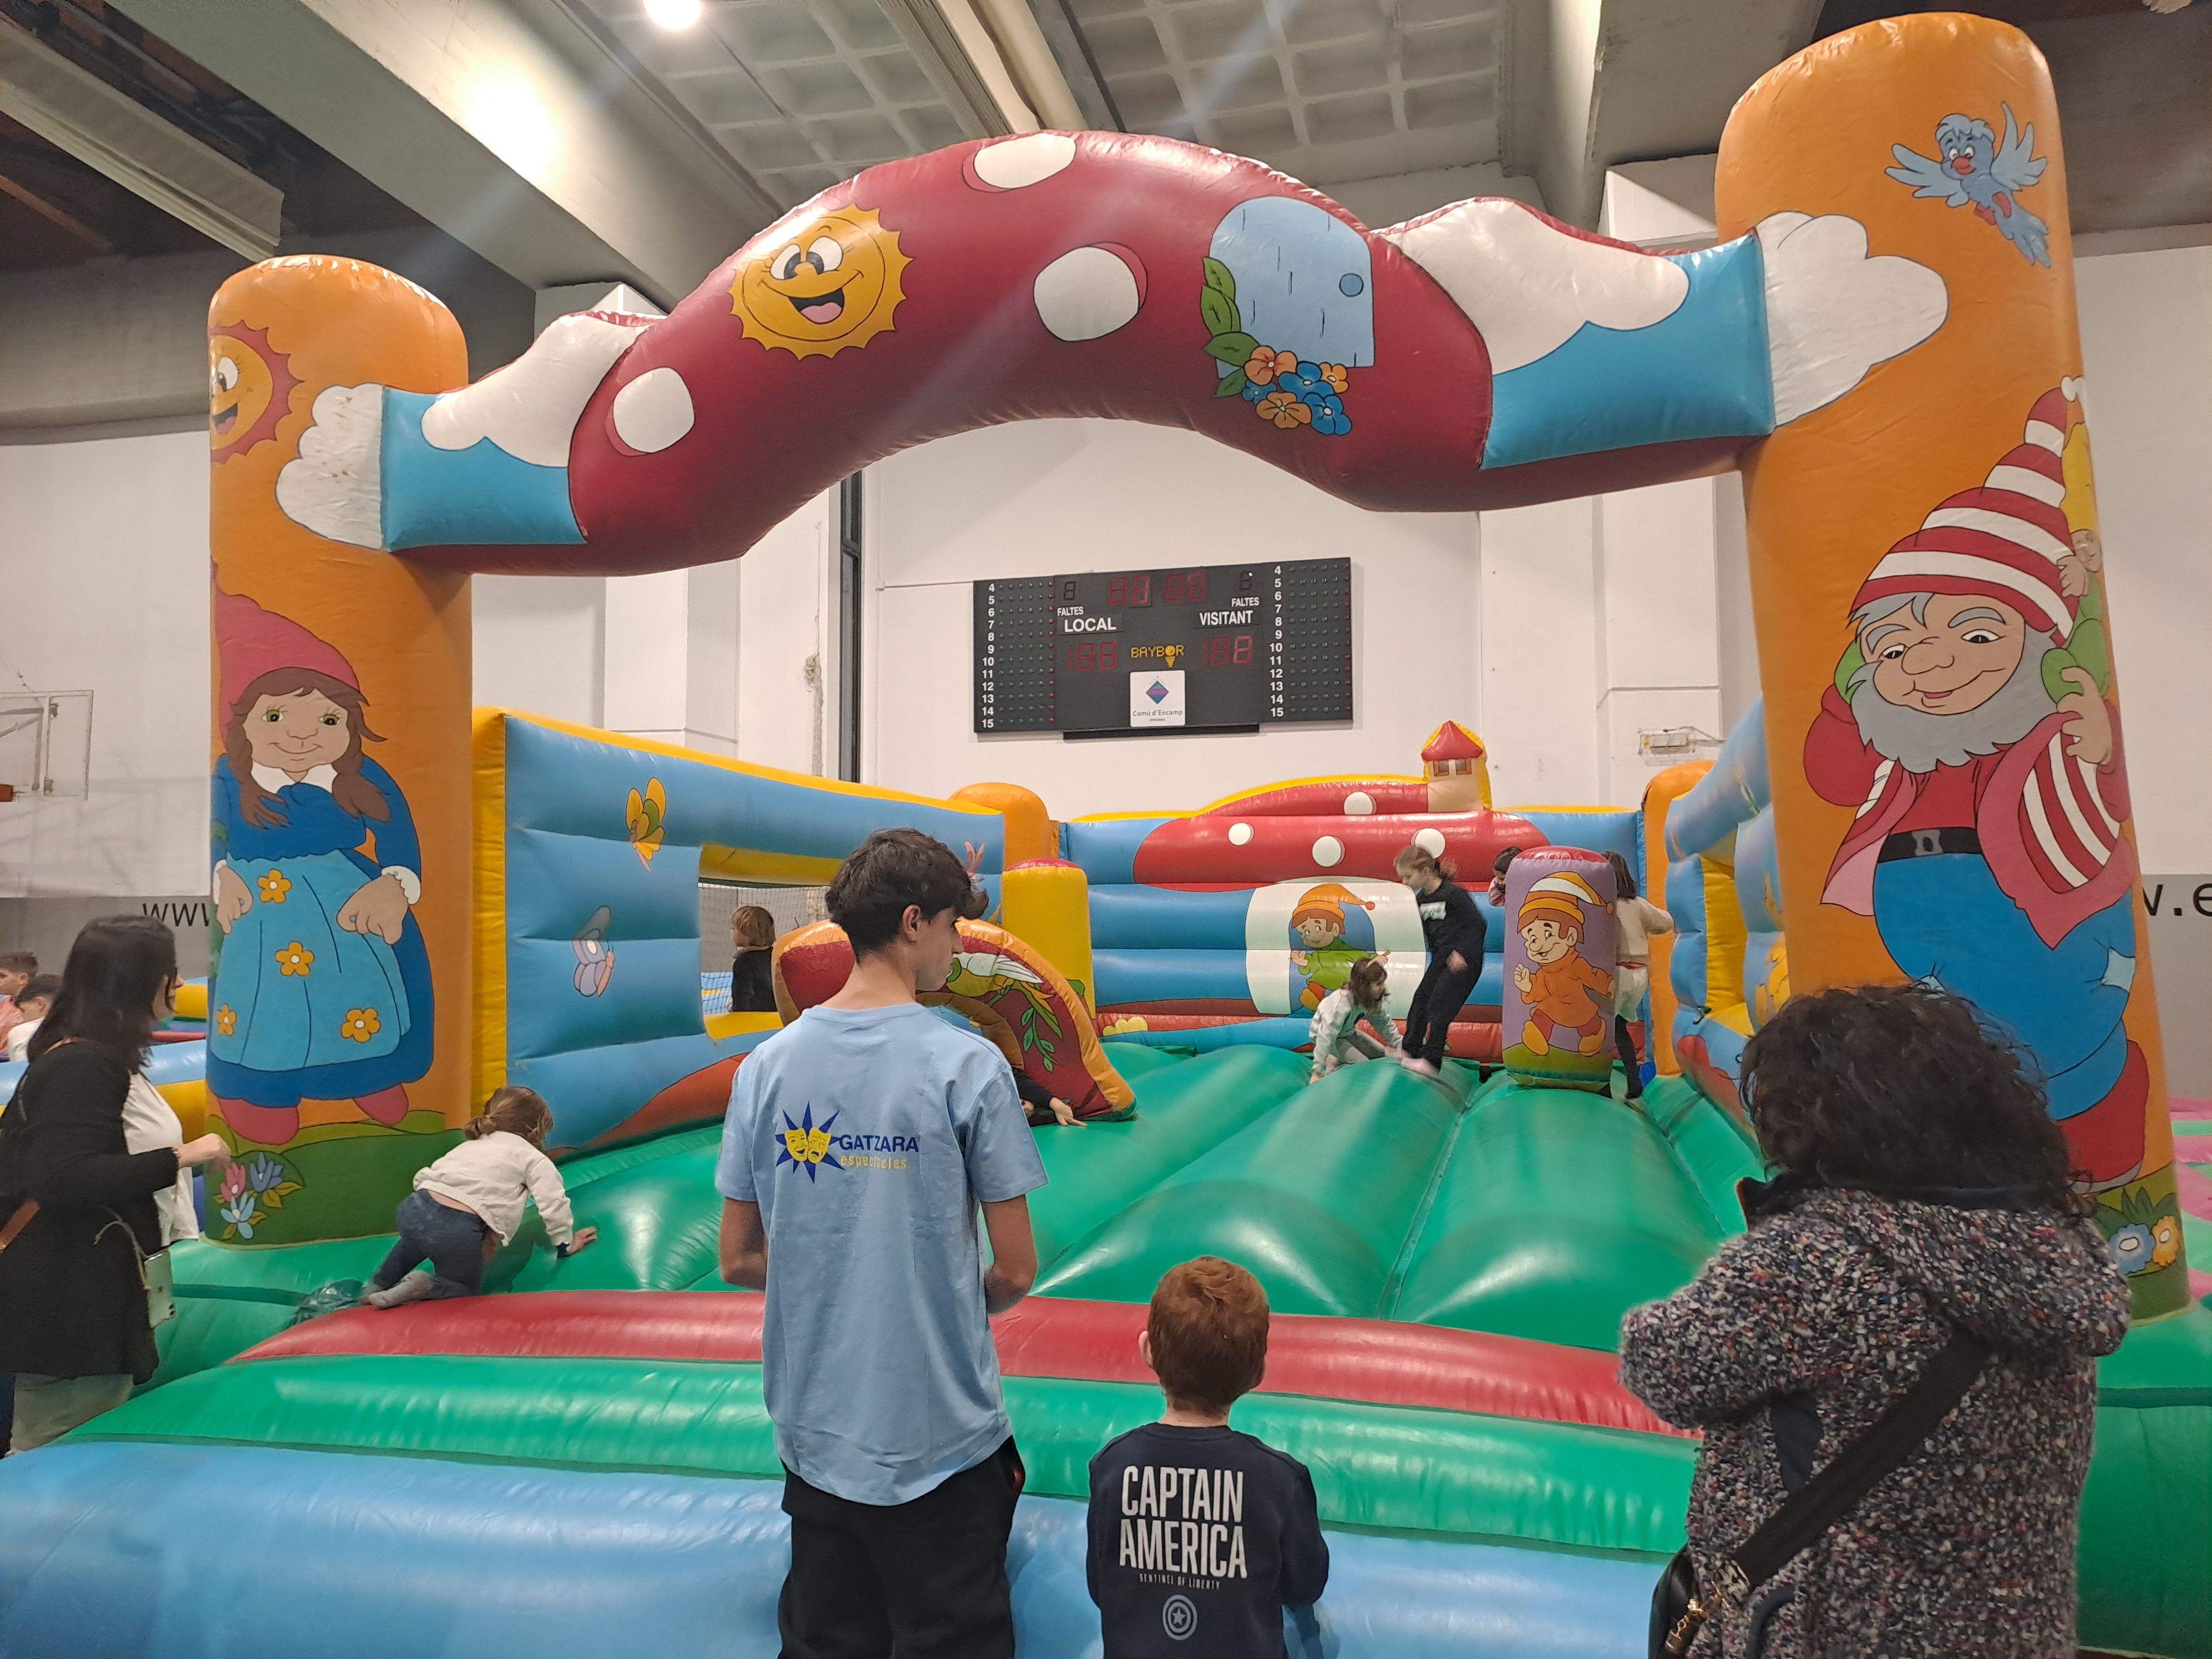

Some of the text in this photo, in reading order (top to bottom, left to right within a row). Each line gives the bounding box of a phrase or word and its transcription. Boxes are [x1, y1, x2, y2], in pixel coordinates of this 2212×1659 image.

[1274, 566, 1282, 575] 4
[1274, 578, 1282, 587] 5
[988, 583, 995, 592] 4
[988, 596, 995, 604] 5
[1274, 591, 1282, 601] 6
[1231, 597, 1260, 607] FALTES
[988, 608, 995, 617] 6
[1057, 606, 1084, 617] FALTES
[1275, 604, 1282, 613] 7
[1199, 610, 1254, 626] VISITANT
[1275, 617, 1282, 627] 8
[988, 620, 995, 629] 7
[1064, 617, 1117, 633] LOCAL
[988, 633, 994, 641] 8
[1275, 630, 1282, 639] 9
[988, 645, 994, 654] 9
[1131, 644, 1185, 659] BAYBOR
[1270, 643, 1282, 652] 10
[982, 657, 994, 666] 10
[1270, 656, 1282, 665] 11
[982, 670, 993, 679] 11
[1270, 669, 1283, 678] 12
[982, 682, 994, 691] 12
[1270, 681, 1284, 691] 13
[982, 695, 994, 703] 13
[1270, 695, 1284, 704] 14
[982, 707, 994, 716] 14
[1271, 707, 1284, 717] 15
[982, 719, 994, 728] 15
[839, 1134, 919, 1152] GATZARA
[1121, 1465, 1243, 1522] CAPTAIN
[1119, 1519, 1248, 1578] AMERICA
[1139, 1573, 1220, 1590] SENTINEL OF LIBERTY
